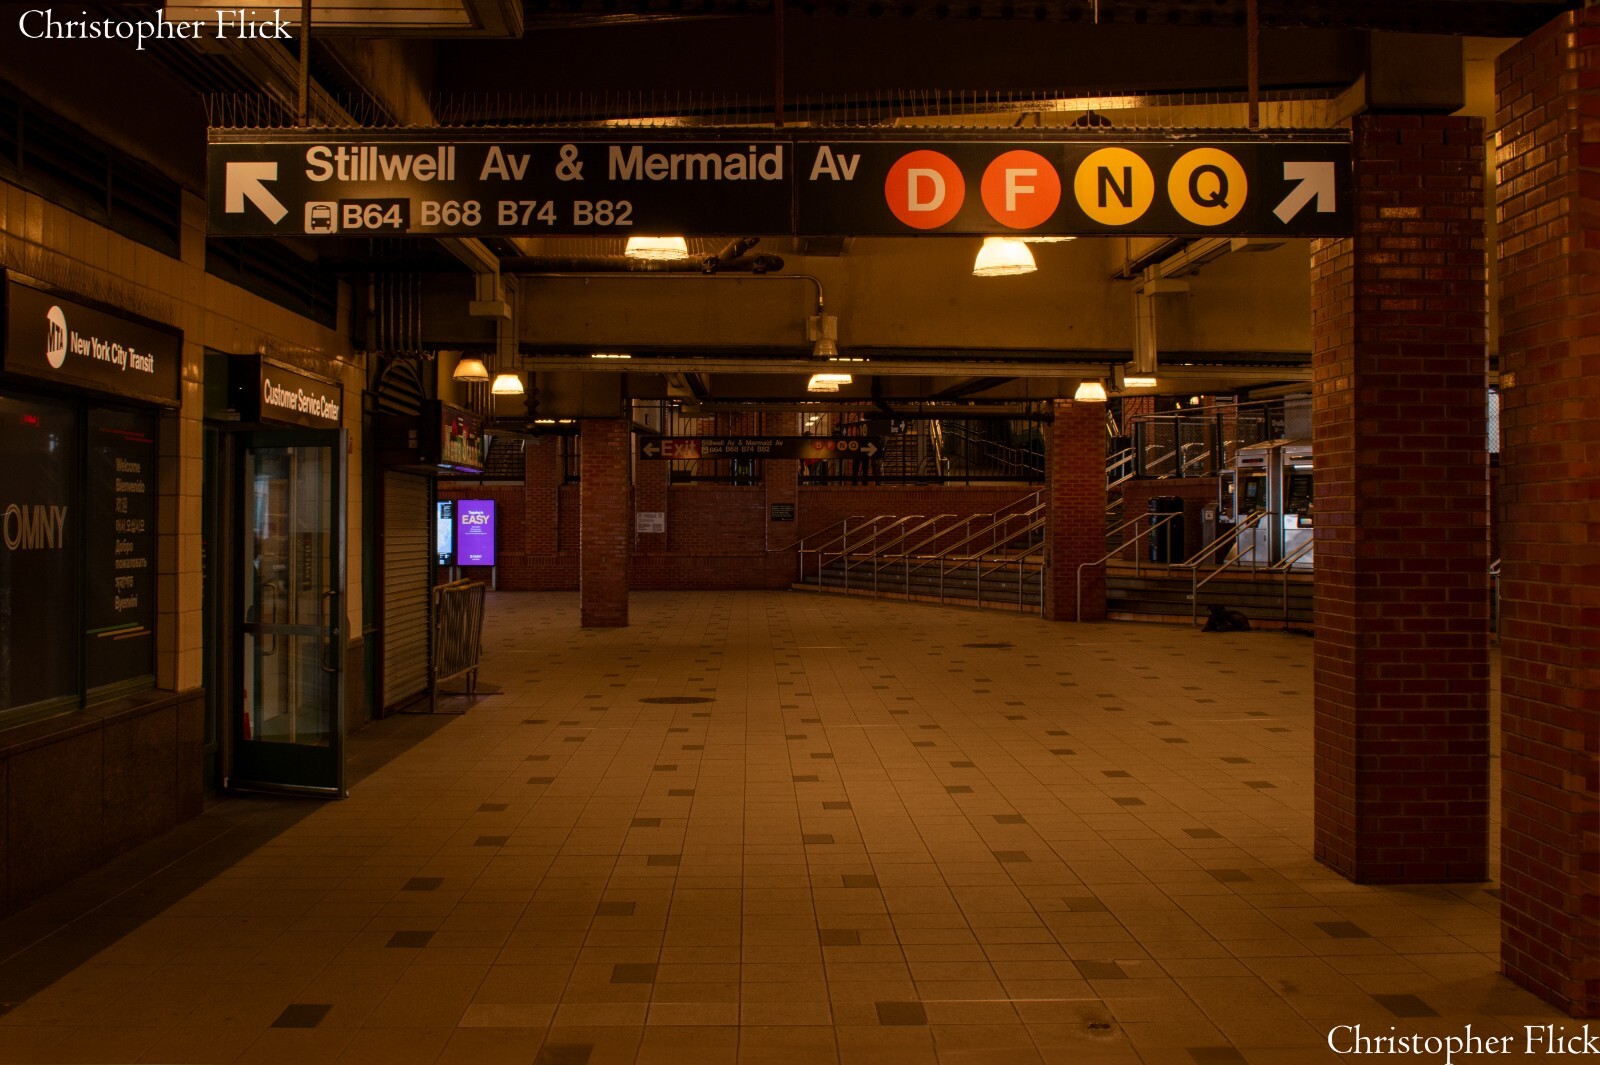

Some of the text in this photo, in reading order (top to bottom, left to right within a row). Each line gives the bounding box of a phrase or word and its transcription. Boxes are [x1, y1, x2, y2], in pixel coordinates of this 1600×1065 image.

[304, 144, 861, 182] Stillwell Av & Mermaid Av
[907, 164, 1229, 212] D F N Q
[342, 200, 633, 229] B64 B68 B74 B82
[70, 331, 91, 357] New
[91, 336, 111, 362] York
[111, 343, 128, 371] City
[128, 348, 154, 374] Transit
[264, 378, 340, 421] Customer Service Center
[661, 439, 697, 457] Exit
[115, 457, 141, 474] Welcome
[115, 478, 145, 493] Bienvenido
[4, 503, 67, 551] OMNY
[462, 514, 490, 525] EASY
[115, 593, 138, 612] Byenvini
